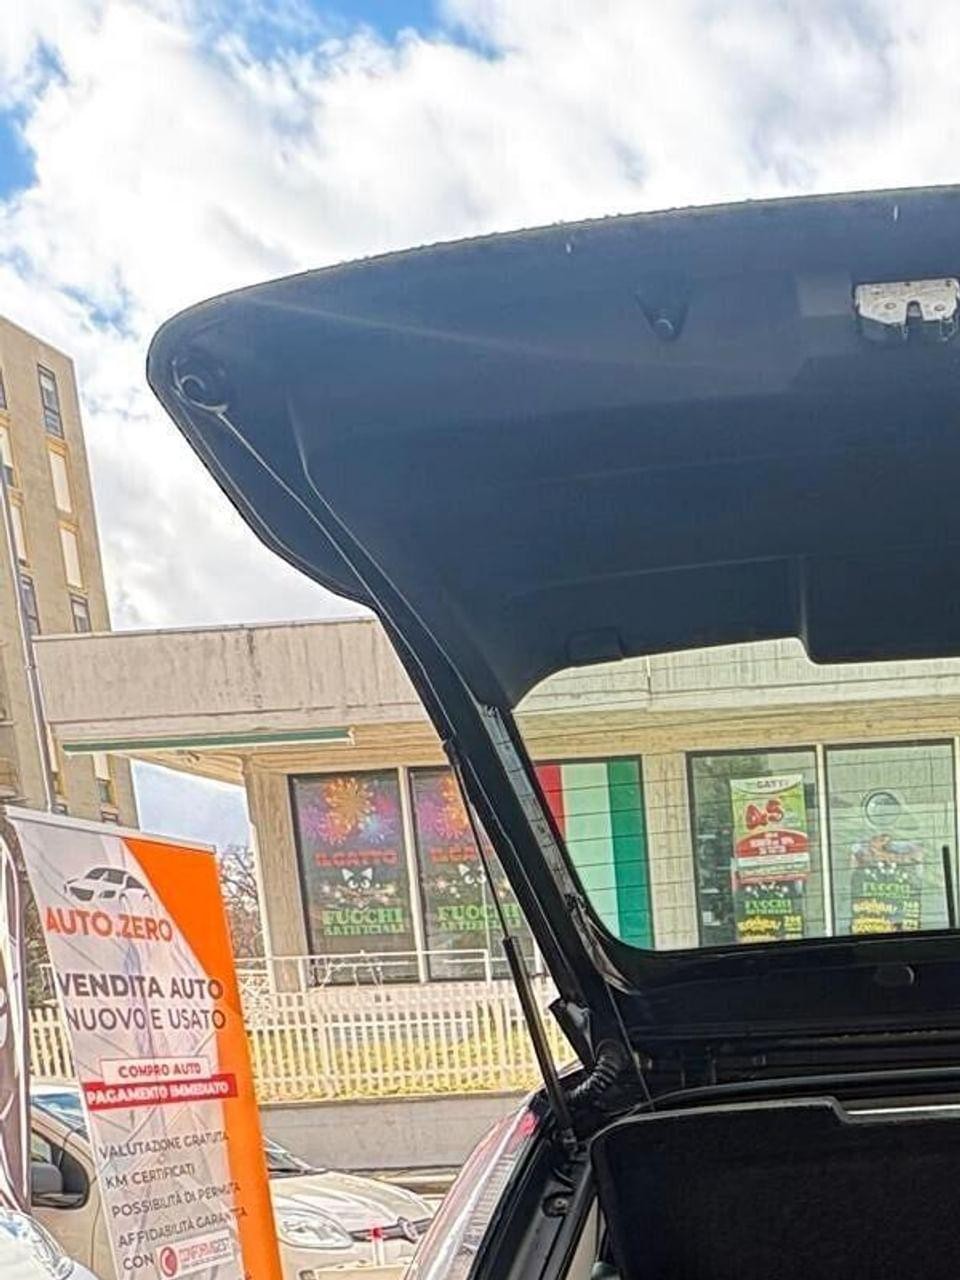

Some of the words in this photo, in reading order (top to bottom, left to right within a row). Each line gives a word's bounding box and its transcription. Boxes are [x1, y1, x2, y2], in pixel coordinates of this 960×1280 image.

[46, 906, 173, 942] AUTO.ZERO
[321, 907, 404, 925] FUOCHI
[56, 973, 164, 998] VENDITA
[170, 977, 224, 1000] AUTO
[66, 1008, 146, 1031] NUOVO
[151, 1009, 163, 1030] E
[168, 1009, 226, 1030] USATO
[118, 1063, 170, 1078] COMPRO
[173, 1062, 201, 1075] AUTO
[87, 1084, 169, 1105] PAGAMENTO
[170, 1081, 229, 1098] IMMEDIATO
[99, 1138, 182, 1159] VALUTAZIONE
[105, 1175, 128, 1189] KM
[131, 1163, 196, 1185] CERTIFICATI
[185, 1191, 197, 1204] DI
[123, 1253, 155, 1271] CON
